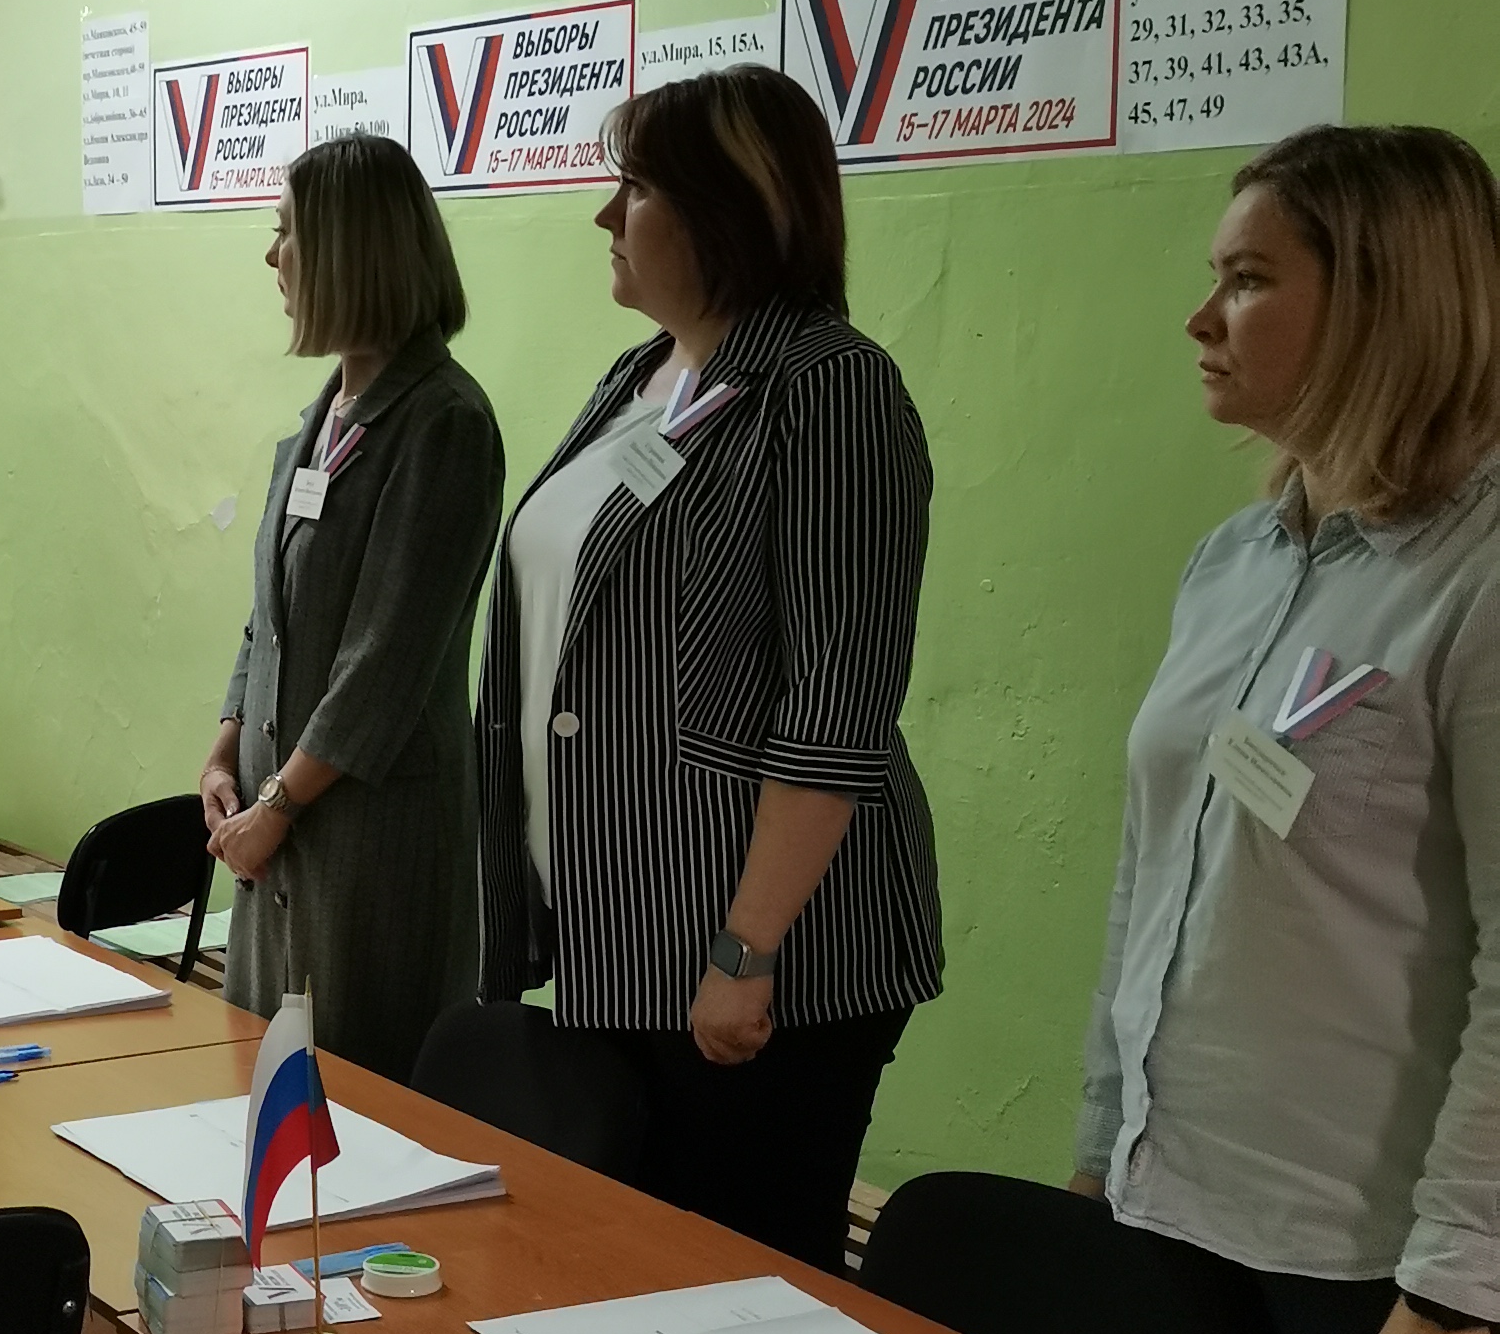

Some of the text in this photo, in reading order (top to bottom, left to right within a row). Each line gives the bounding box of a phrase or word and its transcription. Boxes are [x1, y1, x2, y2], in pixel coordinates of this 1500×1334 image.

[1130, 0, 1312, 42] 29, 31, 32, 33, 35,
[512, 19, 600, 61] ВЫБОРЫ
[641, 43, 704, 70] ул.Мира,
[708, 36, 726, 58] 15,
[226, 65, 285, 95] ВЫБОРЫ
[503, 58, 626, 100] ПРЕЗИДЕНТА
[908, 54, 1023, 101] РОССИИ
[1128, 60, 1158, 85] 37,
[1164, 56, 1195, 81] 39,
[1201, 50, 1232, 76] 41,
[1238, 47, 1270, 72] 43,
[220, 97, 303, 129] ПРЕЗИДЕНТА
[313, 87, 368, 114] ул.Мира,
[1128, 94, 1225, 126] 45, 47, 49
[494, 105, 571, 141] РОССИИ
[950, 103, 1022, 139] МАРТА
[1022, 97, 1076, 132] 2024
[215, 134, 265, 162] РОССИИ
[522, 144, 569, 171] МАРТА
[234, 167, 266, 188] МАРТА
[266, 165, 288, 187] 202
